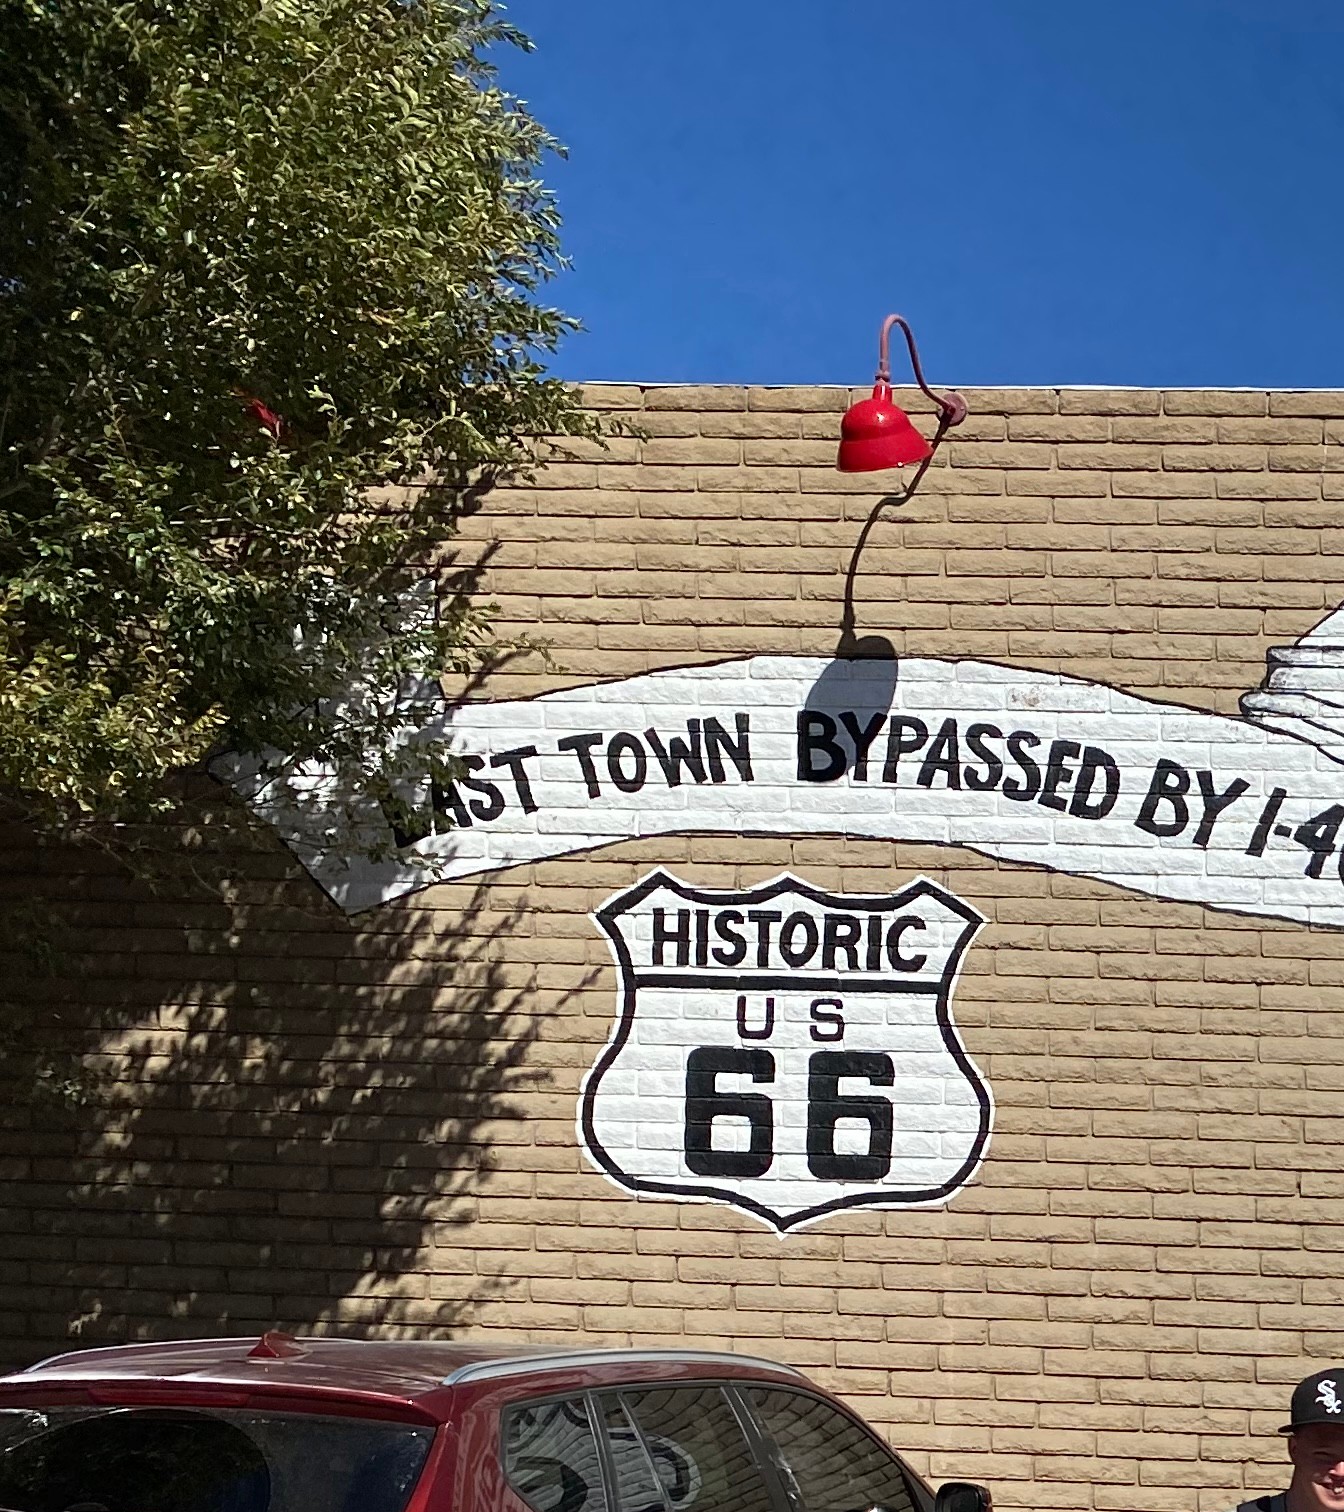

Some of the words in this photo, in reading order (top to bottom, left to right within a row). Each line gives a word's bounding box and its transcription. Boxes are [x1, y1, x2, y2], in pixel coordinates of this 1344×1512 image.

[438, 744, 540, 829] AST
[557, 711, 752, 800] TOWN
[797, 709, 1123, 821] BYPASSED
[1134, 757, 1250, 849] BY
[650, 906, 929, 976] HISTORIC
[682, 1046, 897, 1181] 66
